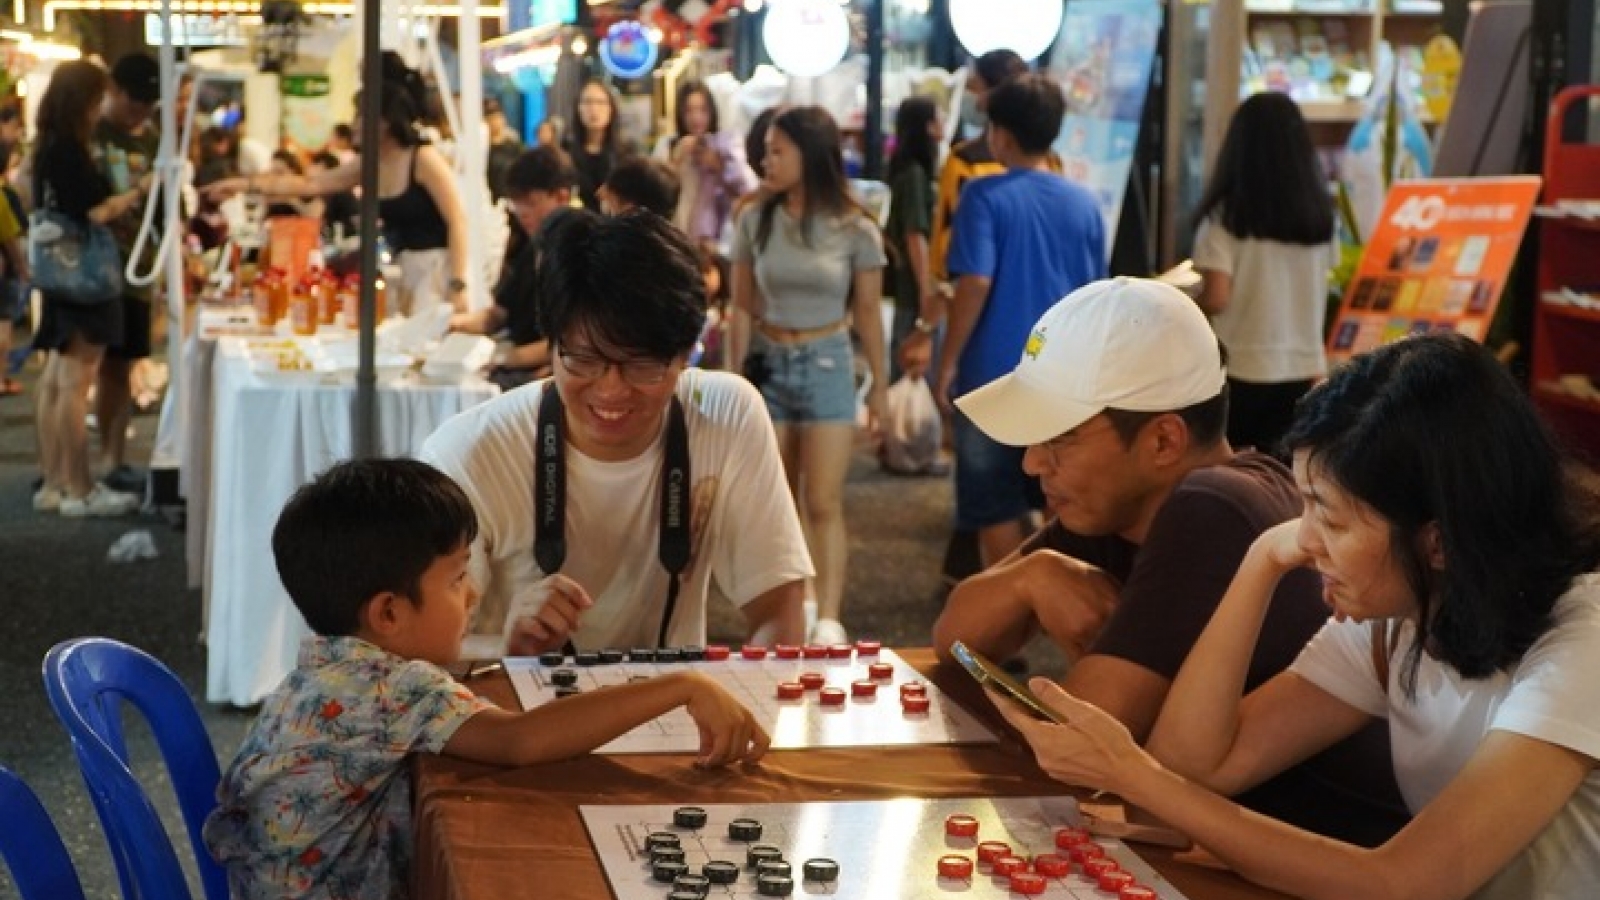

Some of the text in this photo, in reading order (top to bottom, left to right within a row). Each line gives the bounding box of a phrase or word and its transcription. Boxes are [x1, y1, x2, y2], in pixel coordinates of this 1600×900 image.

[1390, 196, 1445, 231] 40
[544, 424, 557, 526] EOS DIGITAL
[668, 468, 683, 528] Canon
